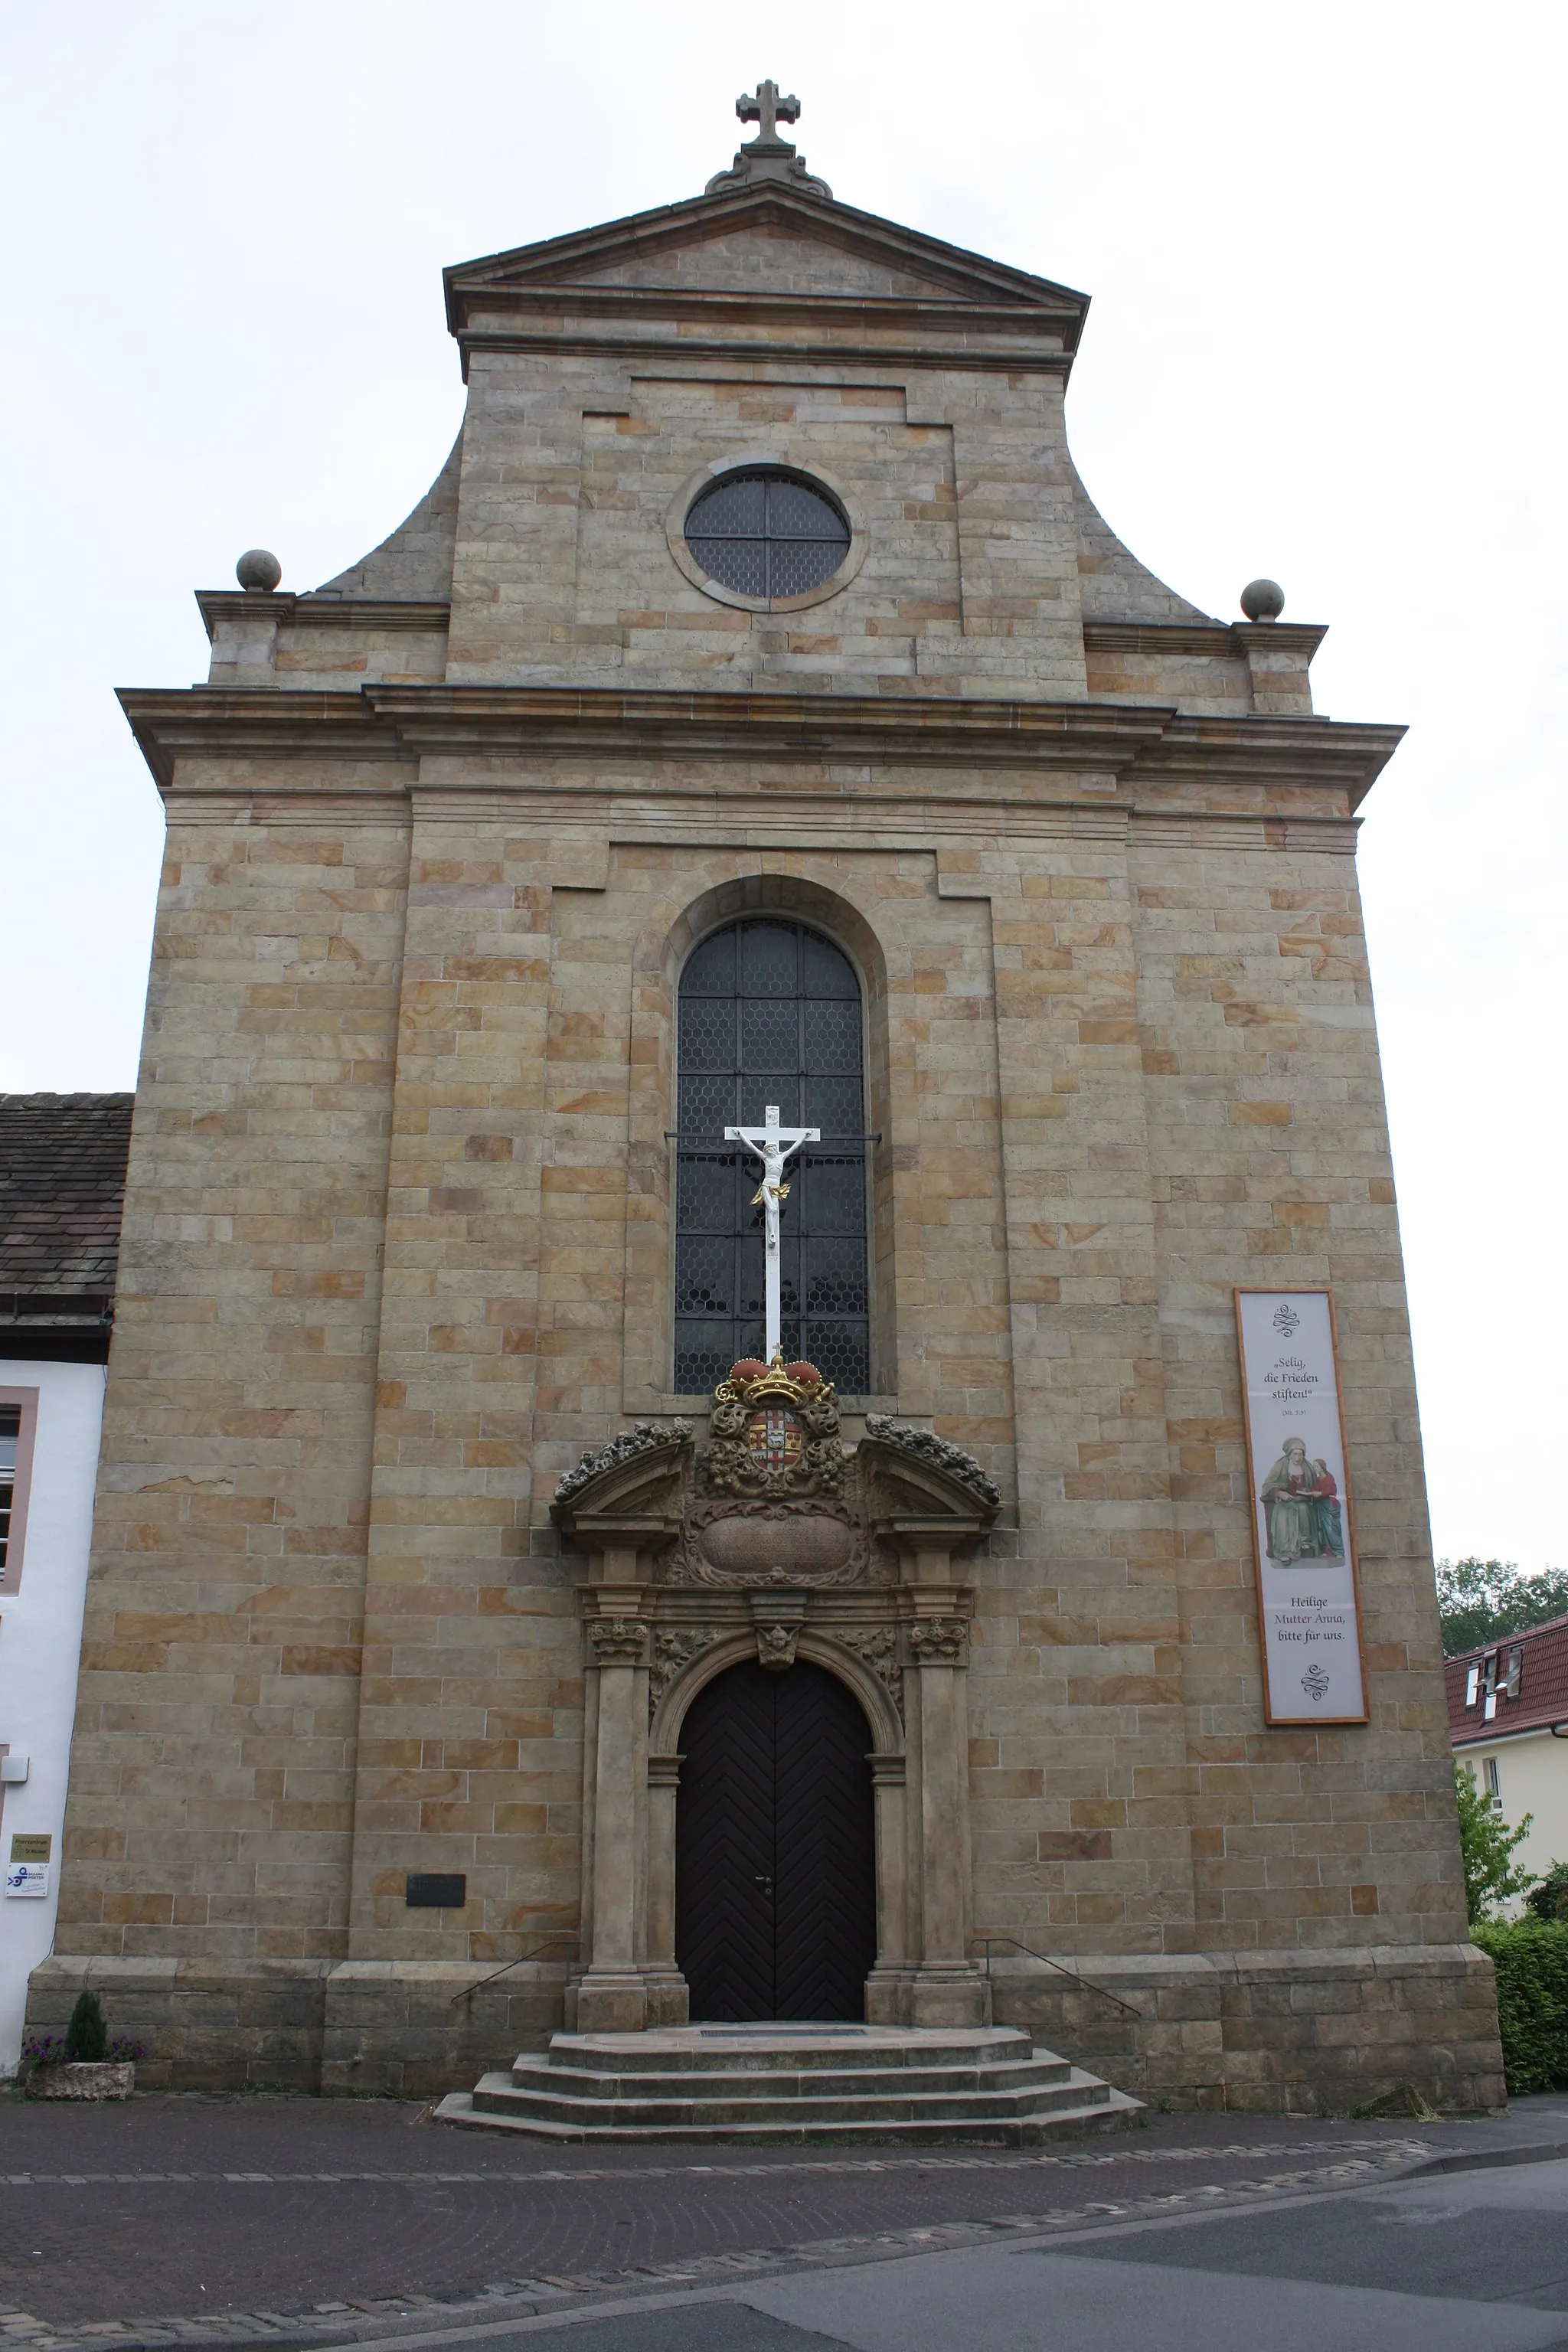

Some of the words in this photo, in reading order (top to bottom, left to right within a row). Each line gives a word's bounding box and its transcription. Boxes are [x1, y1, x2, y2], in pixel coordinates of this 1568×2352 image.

[1264, 1372, 1279, 1383] die
[1281, 1372, 1318, 1383] Frieden
[1291, 1596, 1328, 1611] Heilige
[1275, 1614, 1312, 1624] Mutter
[1314, 1614, 1345, 1625] Anna,
[1278, 1630, 1302, 1641] bitte
[1303, 1629, 1321, 1645] für
